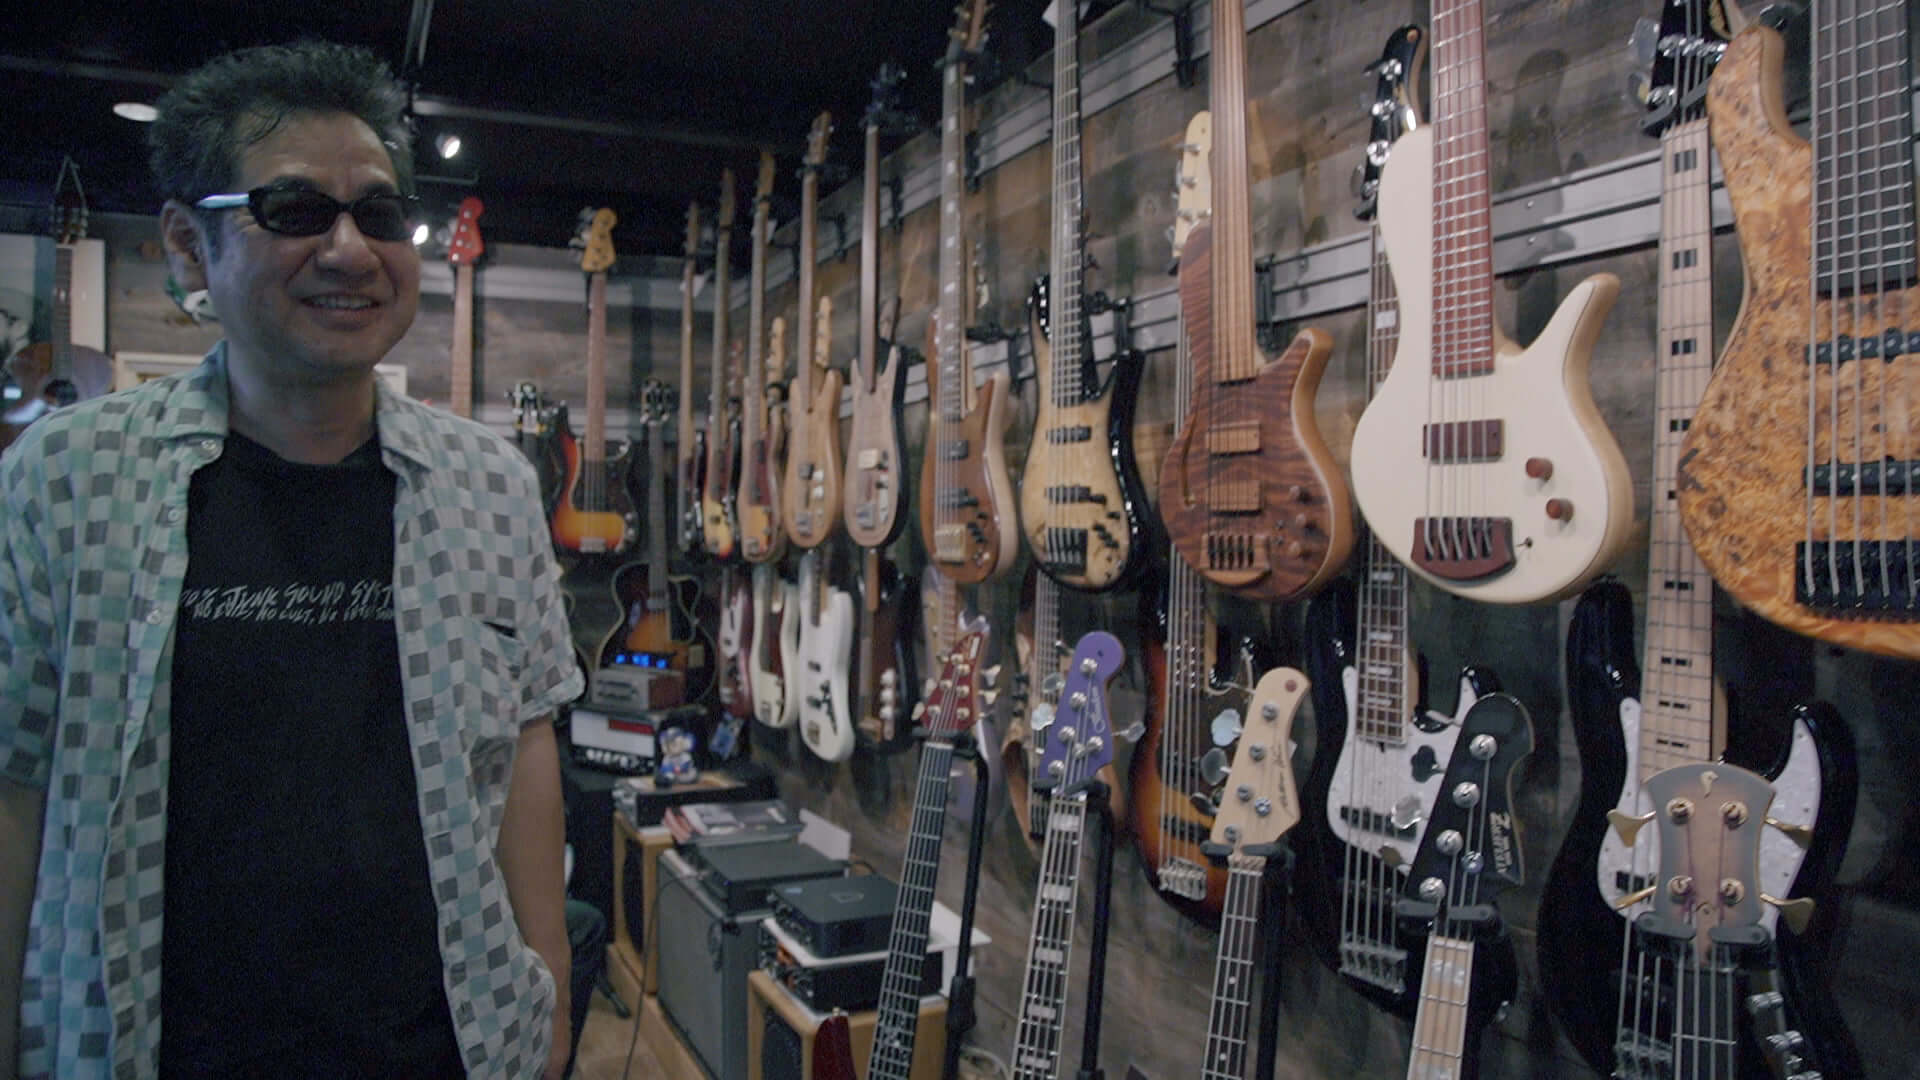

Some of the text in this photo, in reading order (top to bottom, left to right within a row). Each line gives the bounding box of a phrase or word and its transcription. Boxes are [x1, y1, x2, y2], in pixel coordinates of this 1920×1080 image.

[221, 584, 279, 608] JUNK
[284, 581, 345, 608] SOUND
[255, 602, 277, 621] NO
